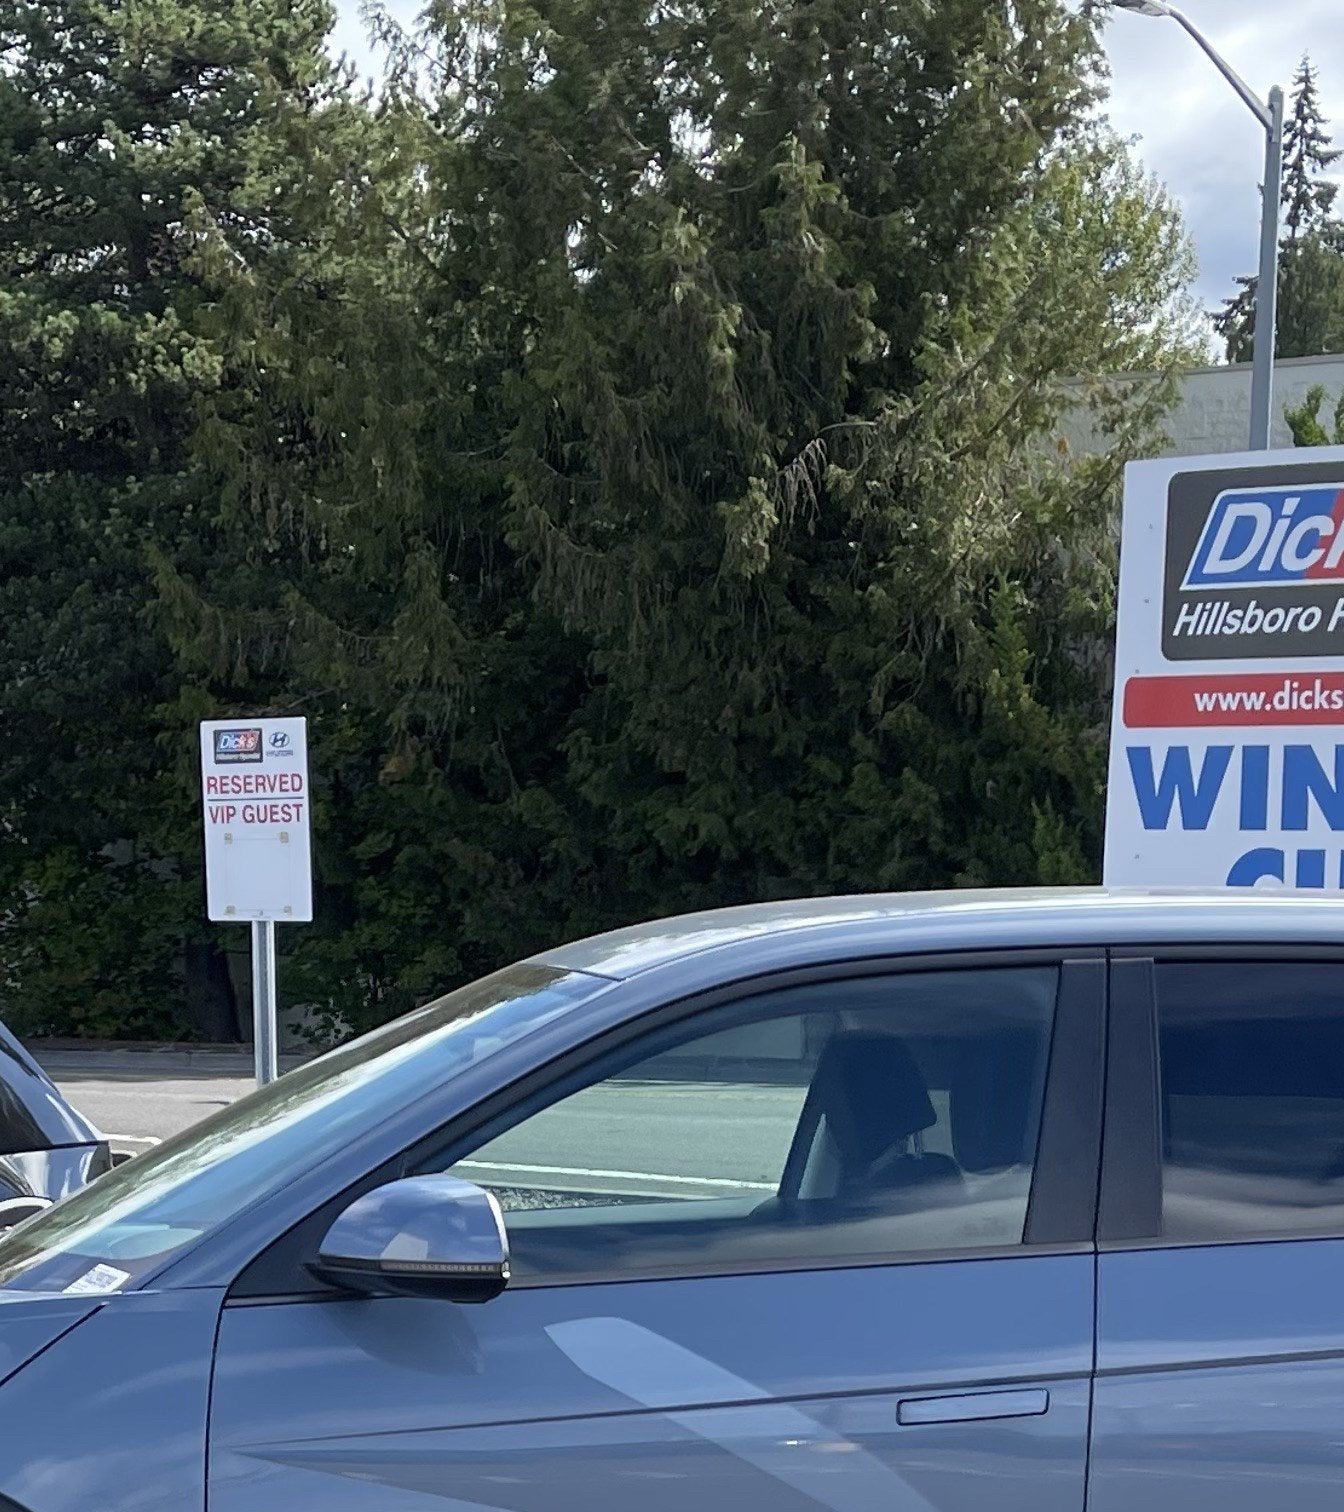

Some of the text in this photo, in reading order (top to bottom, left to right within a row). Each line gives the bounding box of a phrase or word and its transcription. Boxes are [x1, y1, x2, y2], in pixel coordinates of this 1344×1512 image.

[1172, 600, 1322, 637] Hillsboro
[206, 773, 304, 795] RESERVED
[208, 803, 304, 824] VIP GUEST
